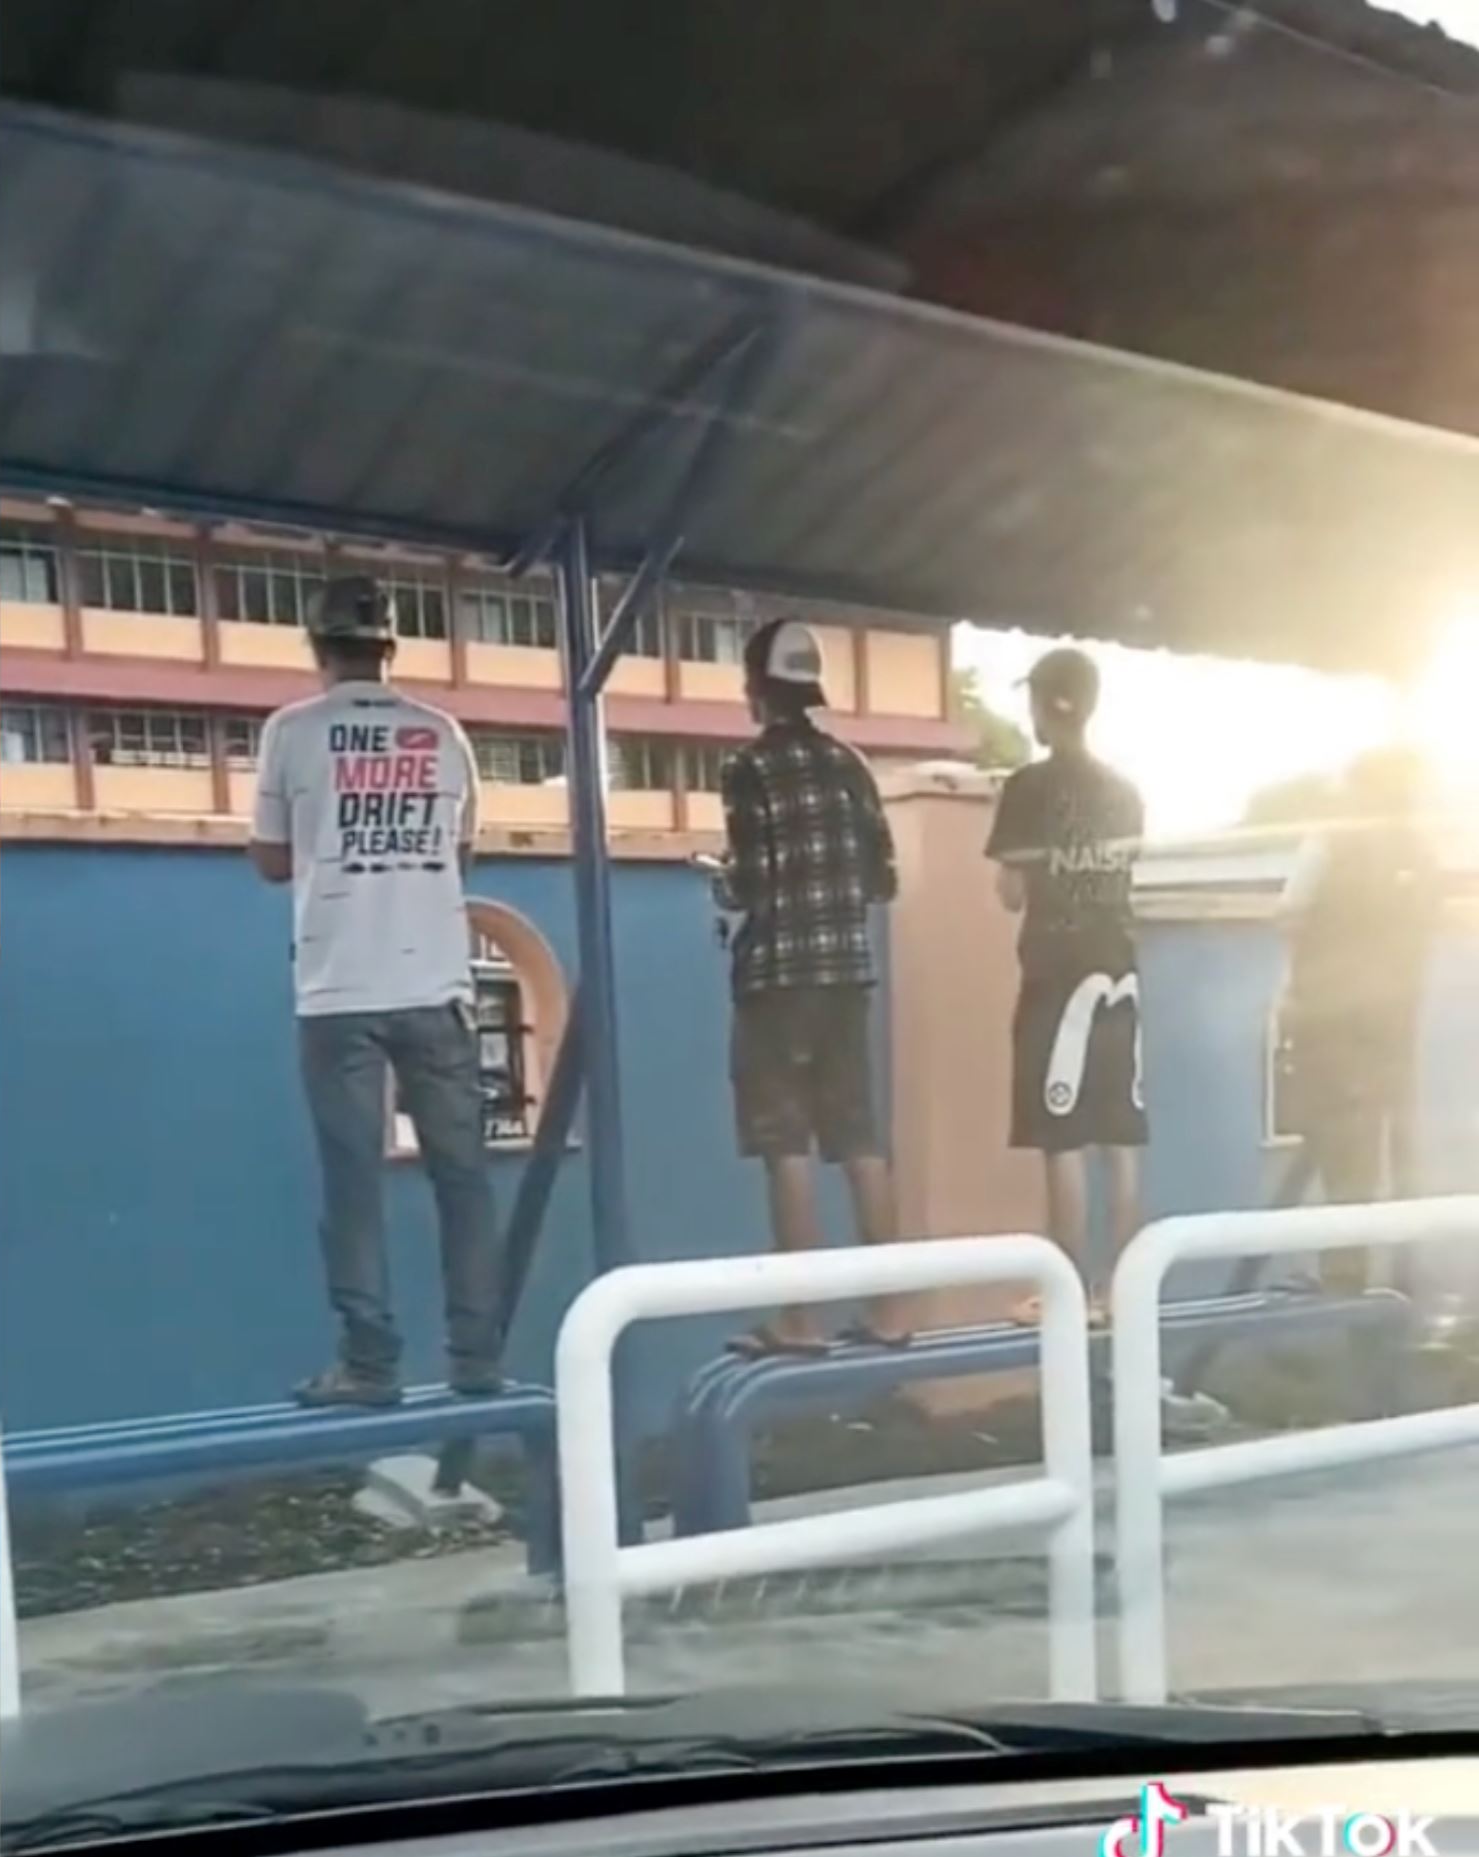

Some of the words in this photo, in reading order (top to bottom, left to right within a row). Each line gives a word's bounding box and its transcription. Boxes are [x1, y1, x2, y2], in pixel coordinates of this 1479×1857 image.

[329, 724, 390, 752] ONE
[335, 756, 439, 790] MORE
[338, 793, 439, 828] DRIFT
[341, 827, 442, 857] PLEASE!
